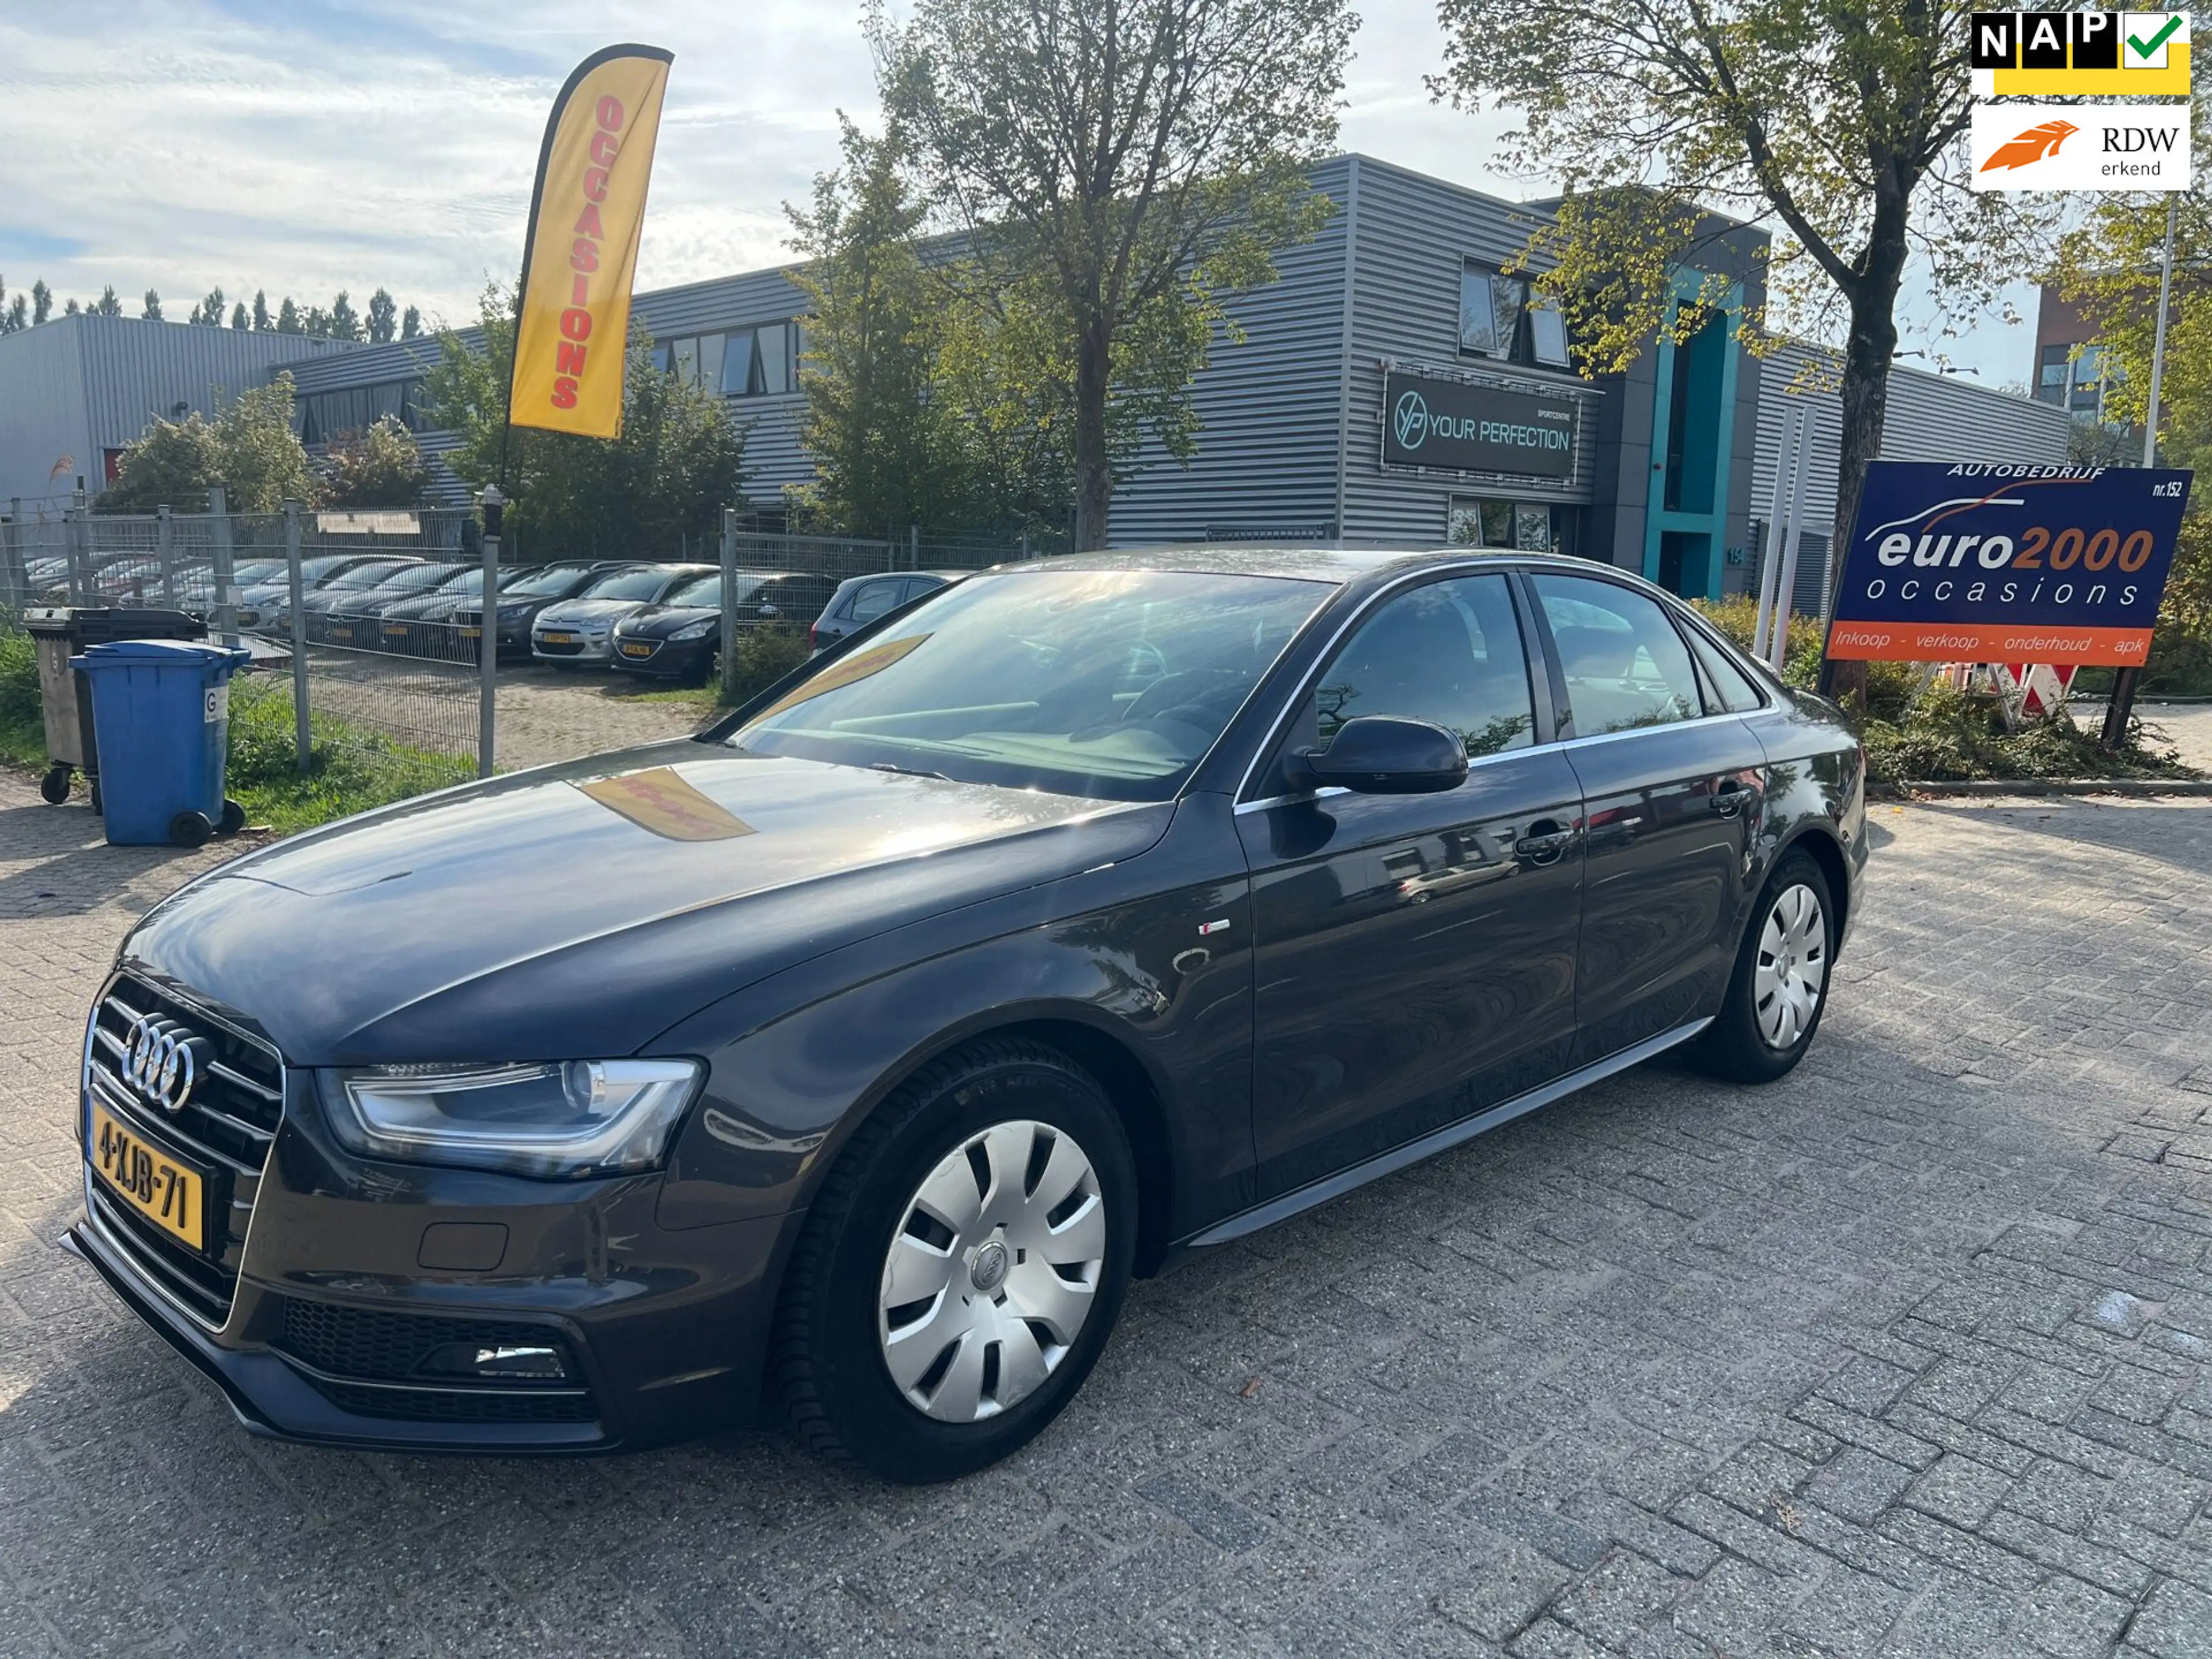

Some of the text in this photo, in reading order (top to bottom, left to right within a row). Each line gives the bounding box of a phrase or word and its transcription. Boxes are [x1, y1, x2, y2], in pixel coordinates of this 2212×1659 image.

[551, 95, 624, 408] OCCASIONS
[1430, 414, 1570, 451] YOUR PERFECTION
[1947, 464, 2106, 480] AUTOBEDRIJF
[2153, 482, 2183, 497] nr.152
[1878, 527, 2154, 572] euro2000
[1868, 577, 2138, 605] occasions
[1836, 631, 2144, 655] Inkoop verkoop onderhoud apk
[207, 692, 216, 712] G
[100, 1122, 185, 1228] 4-XJB-71
